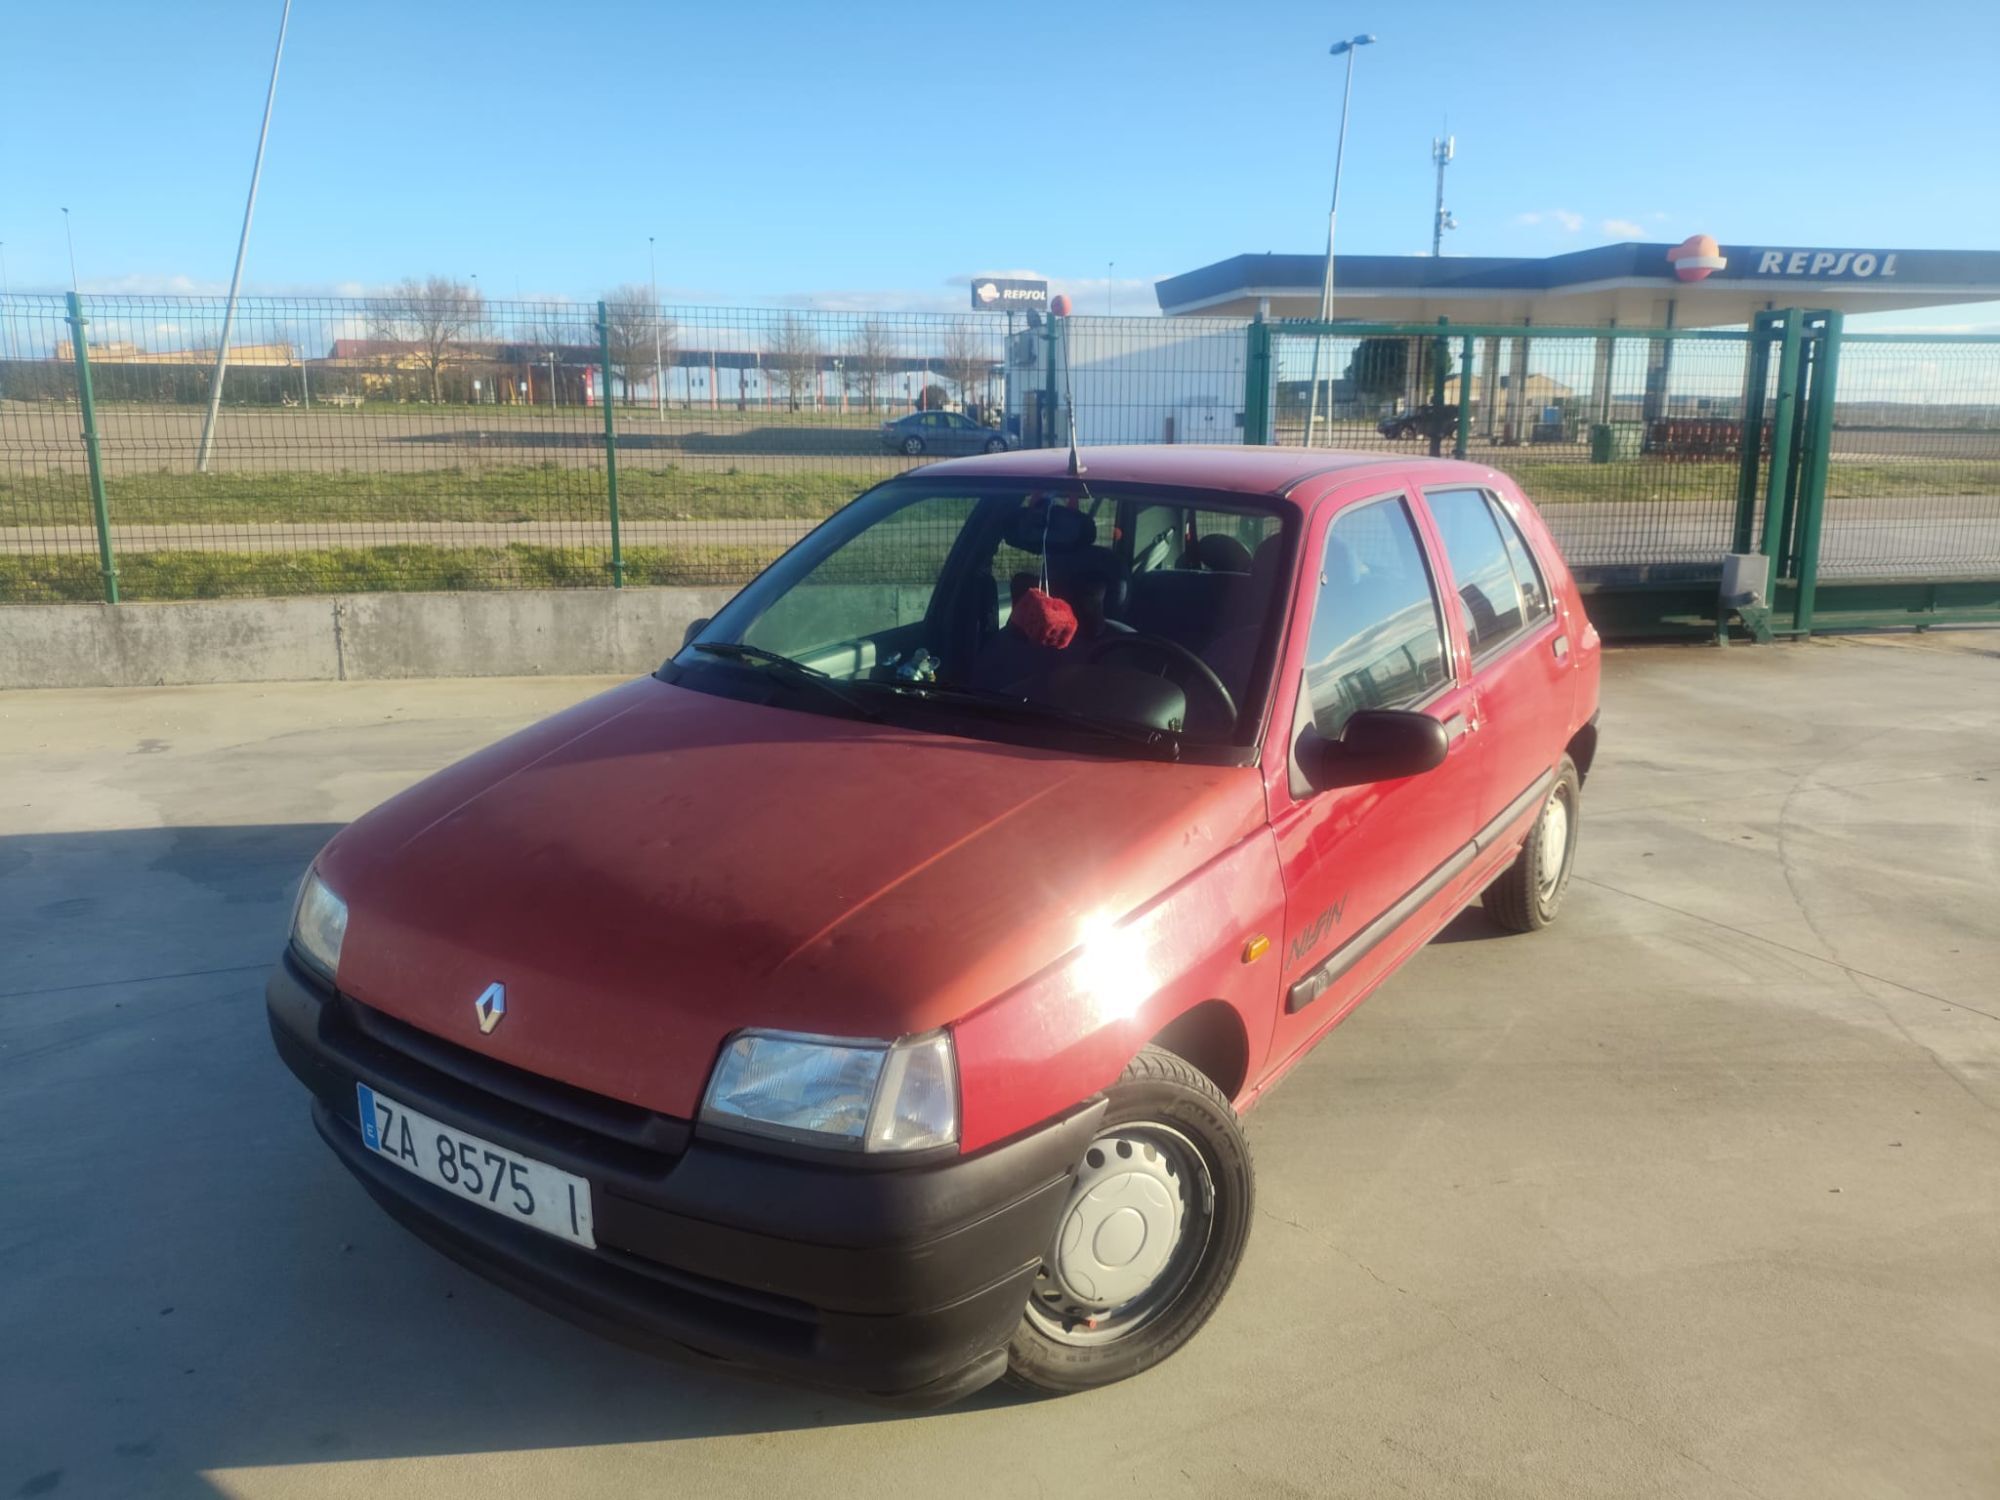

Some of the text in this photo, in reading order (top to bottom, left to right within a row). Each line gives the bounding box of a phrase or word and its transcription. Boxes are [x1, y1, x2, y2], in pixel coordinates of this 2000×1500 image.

[1758, 251, 1897, 277] REPSOL
[1003, 289, 1046, 301] REPSOL
[366, 1122, 375, 1139] E
[375, 1101, 580, 1237] ZA 8575 I
